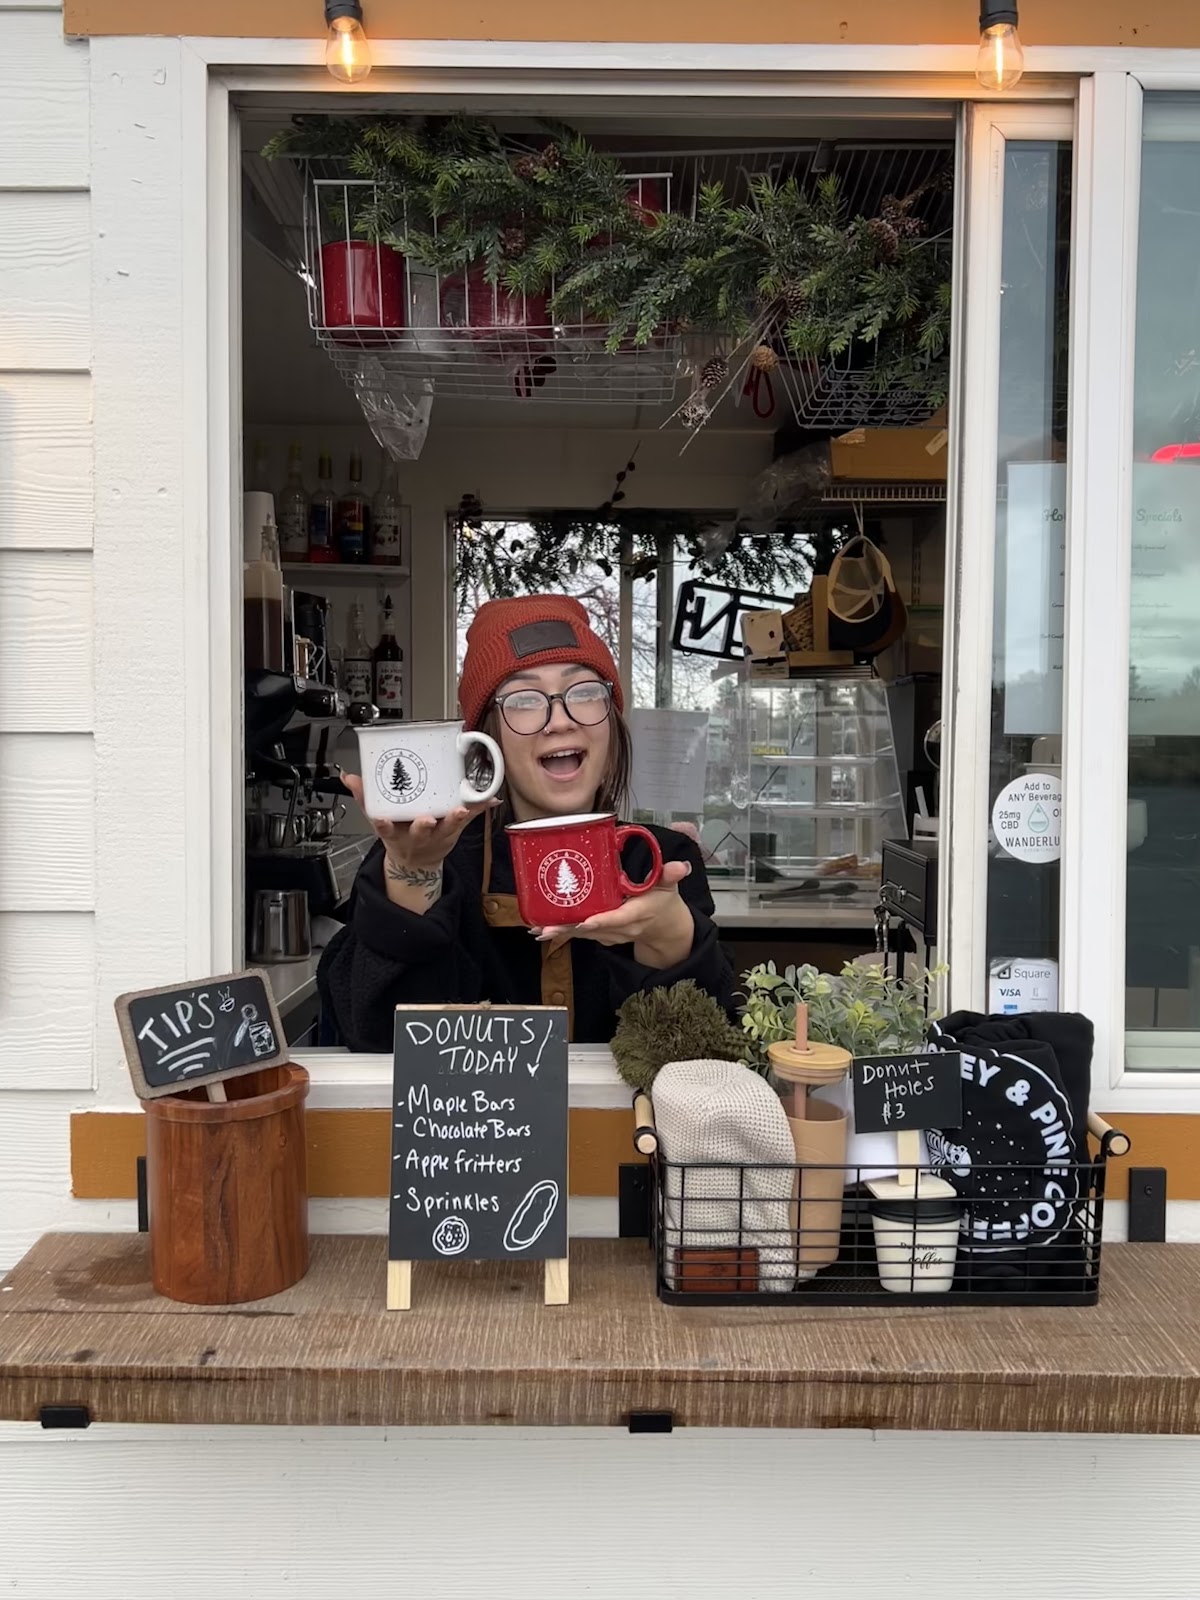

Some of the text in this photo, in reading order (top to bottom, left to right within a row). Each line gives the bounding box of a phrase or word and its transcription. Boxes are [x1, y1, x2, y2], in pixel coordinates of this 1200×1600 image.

[1024, 782, 1051, 791] Add to
[1008, 793, 1026, 802] ANY
[999, 811, 1021, 821] 25mg
[1001, 821, 1019, 830] CBD
[540, 853, 559, 879] HONEY
[574, 854, 591, 871] PINE
[1014, 969, 1051, 980] Square
[999, 988, 1021, 997] VISA
[439, 1046, 519, 1075] TODAY
[863, 1059, 930, 1084] Donut
[885, 1075, 935, 1100] Holes
[472, 1090, 516, 1113] Bars
[487, 1119, 532, 1138] Bars
[1006, 1079, 1031, 1106] &
[1030, 1101, 1072, 1176] PINE
